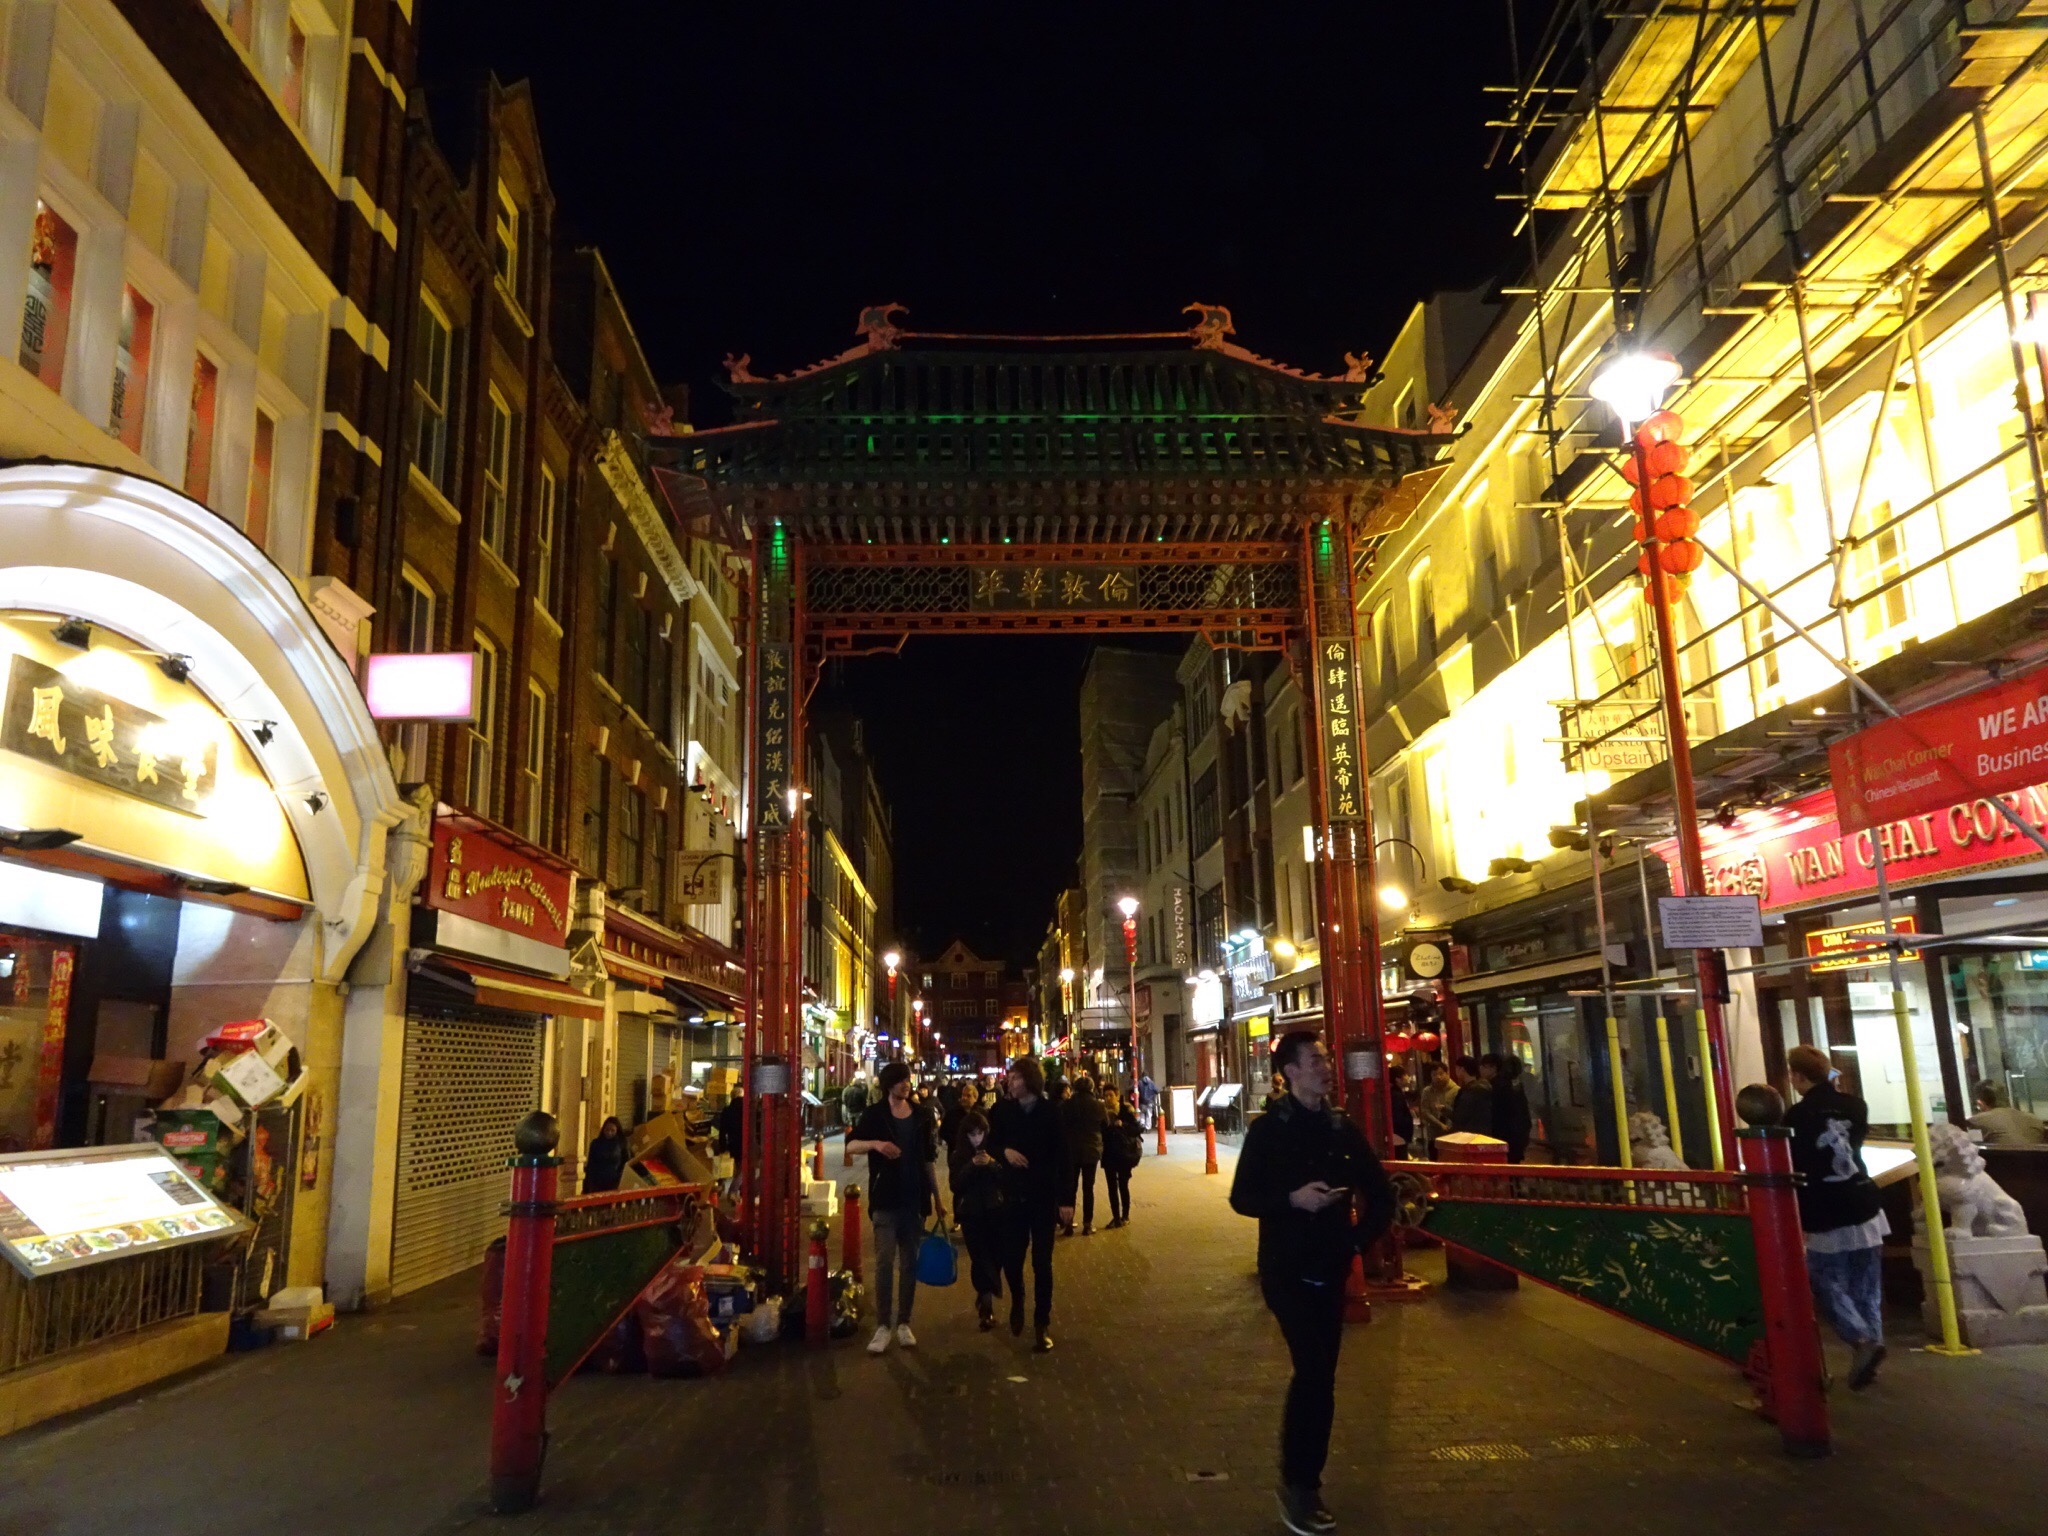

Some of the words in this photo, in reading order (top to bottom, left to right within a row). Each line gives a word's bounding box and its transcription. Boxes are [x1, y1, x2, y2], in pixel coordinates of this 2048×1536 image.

[1978, 707, 2017, 740] WE
[2021, 694, 2048, 730] AR
[1907, 741, 1955, 767] Corner
[1863, 780, 1898, 804] Chinese
[1897, 768, 1942, 795] Restaurant
[1785, 838, 1845, 888] WAN
[1854, 814, 1939, 869] CHAI
[1172, 887, 1186, 950] HAOZHAN
[1821, 931, 1843, 948] DIM
